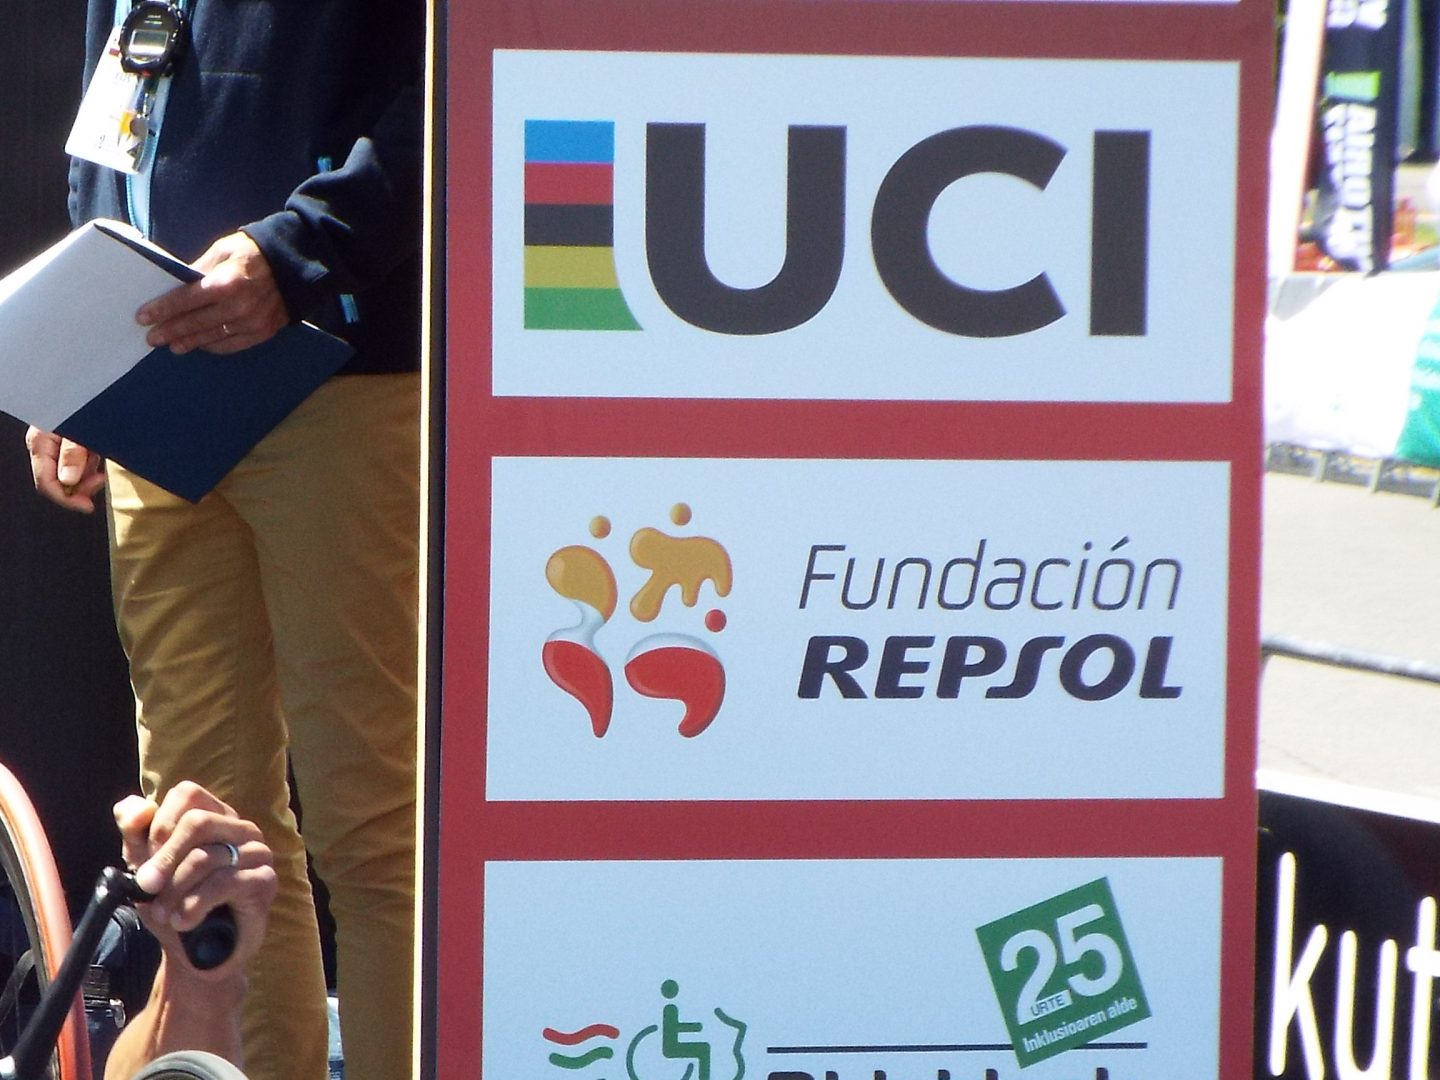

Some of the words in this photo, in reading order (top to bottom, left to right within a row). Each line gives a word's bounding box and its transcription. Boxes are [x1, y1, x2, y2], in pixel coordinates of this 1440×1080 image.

[646, 121, 1153, 339] UCI
[797, 536, 1184, 612] Fundación
[796, 634, 1184, 702] REPSOL
[1000, 903, 1124, 1026] 25
[1022, 1009, 1108, 1053] Inklusioaren
[1106, 996, 1138, 1020] alde
[1030, 994, 1066, 1017] URTE
